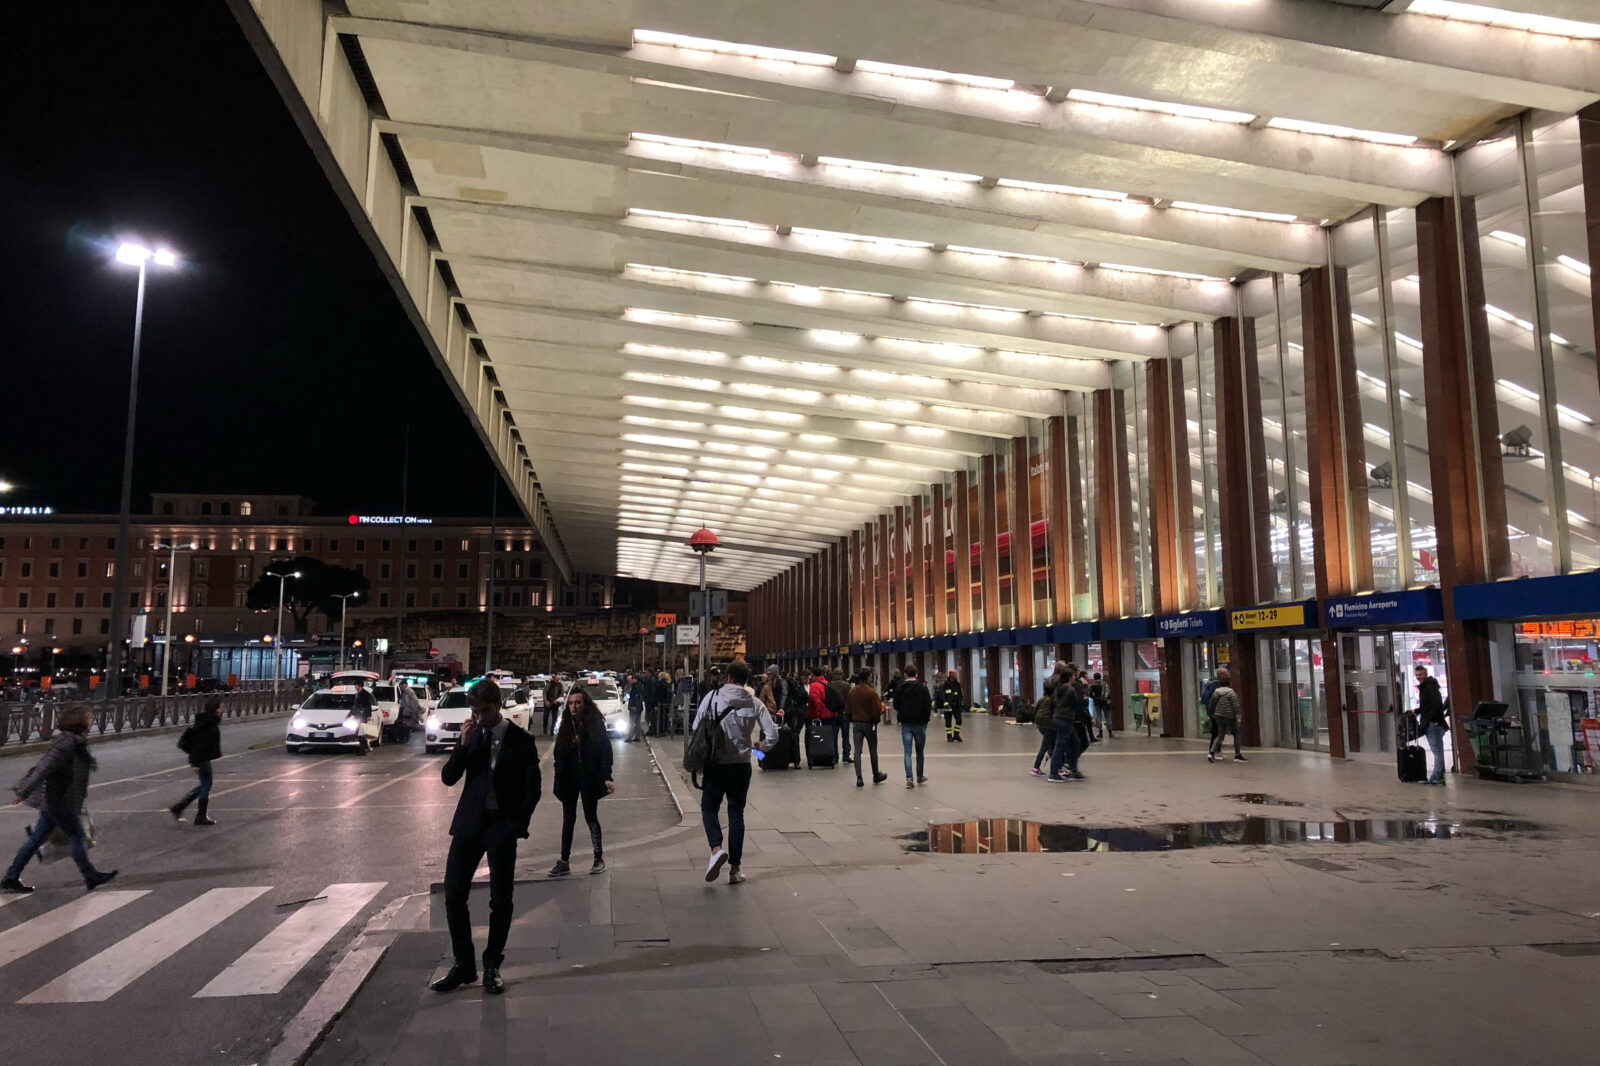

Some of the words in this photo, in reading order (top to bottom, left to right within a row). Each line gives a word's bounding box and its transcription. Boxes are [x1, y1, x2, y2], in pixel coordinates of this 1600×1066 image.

[0, 506, 53, 515] D'ITALIA
[1344, 602, 1368, 612] Fiumicino
[1369, 600, 1398, 610] Aeroporto
[1258, 609, 1278, 621] 12-29
[1169, 618, 1189, 630] Biglietti
[1189, 616, 1204, 627] Tickets
